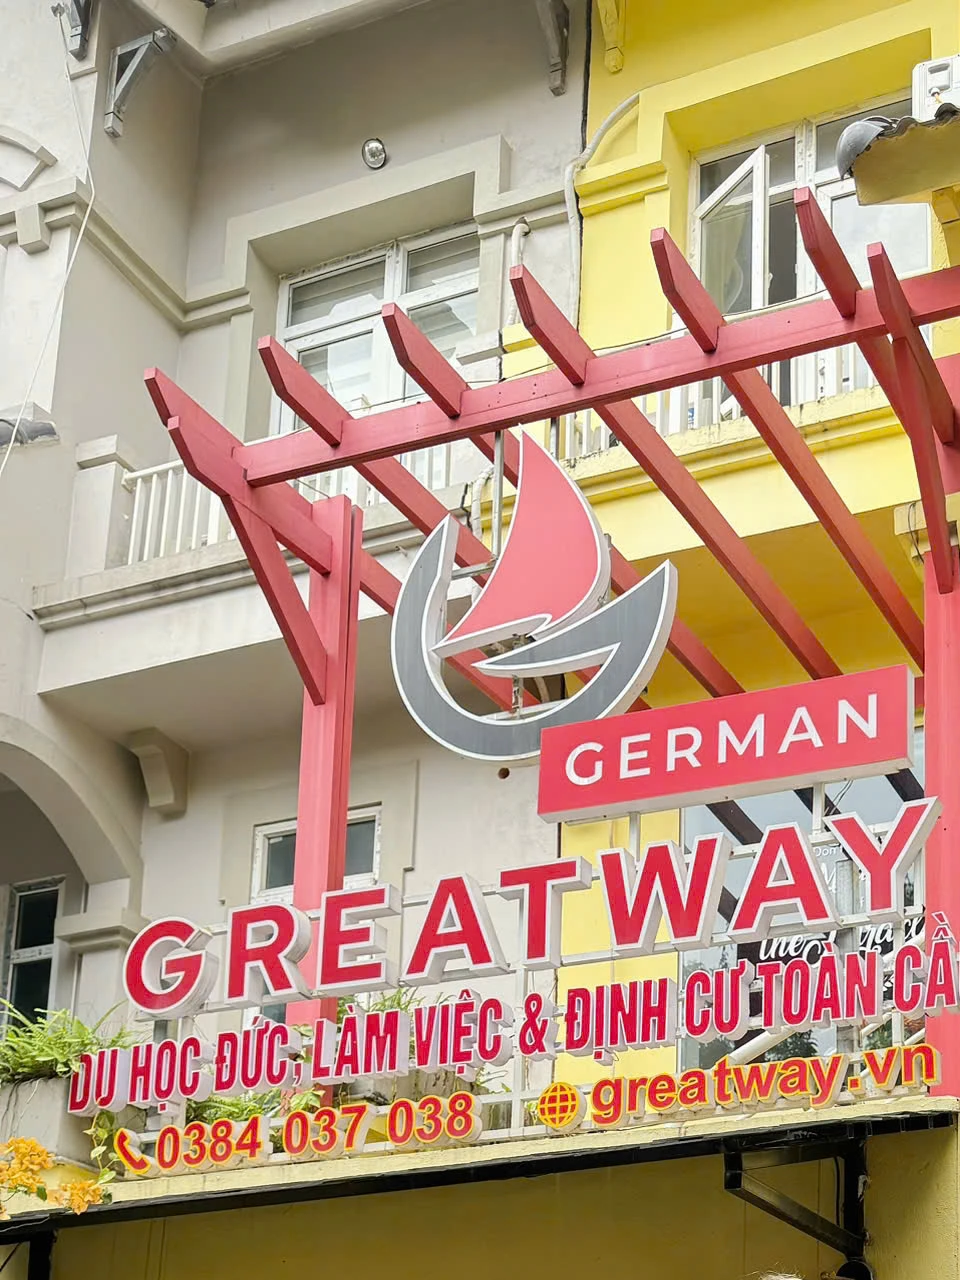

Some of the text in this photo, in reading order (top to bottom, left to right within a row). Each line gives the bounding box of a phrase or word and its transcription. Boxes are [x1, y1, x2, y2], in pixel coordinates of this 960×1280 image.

[565, 694, 877, 786] GERMAN
[123, 796, 940, 1015] GREATWAY
[68, 1044, 122, 1114] DU
[128, 1035, 201, 1114] HỌC
[213, 1014, 302, 1091] ĐỨC,
[311, 1003, 398, 1081] LÀM
[414, 988, 505, 1077] VIỆC
[519, 992, 549, 1056] &
[564, 977, 669, 1061] ĐỊNH
[684, 959, 749, 1039] CƯ
[756, 940, 877, 1028] TOÀN
[591, 1043, 938, 1125] greatway.vn
[155, 1090, 476, 1171] 0384 037 038
